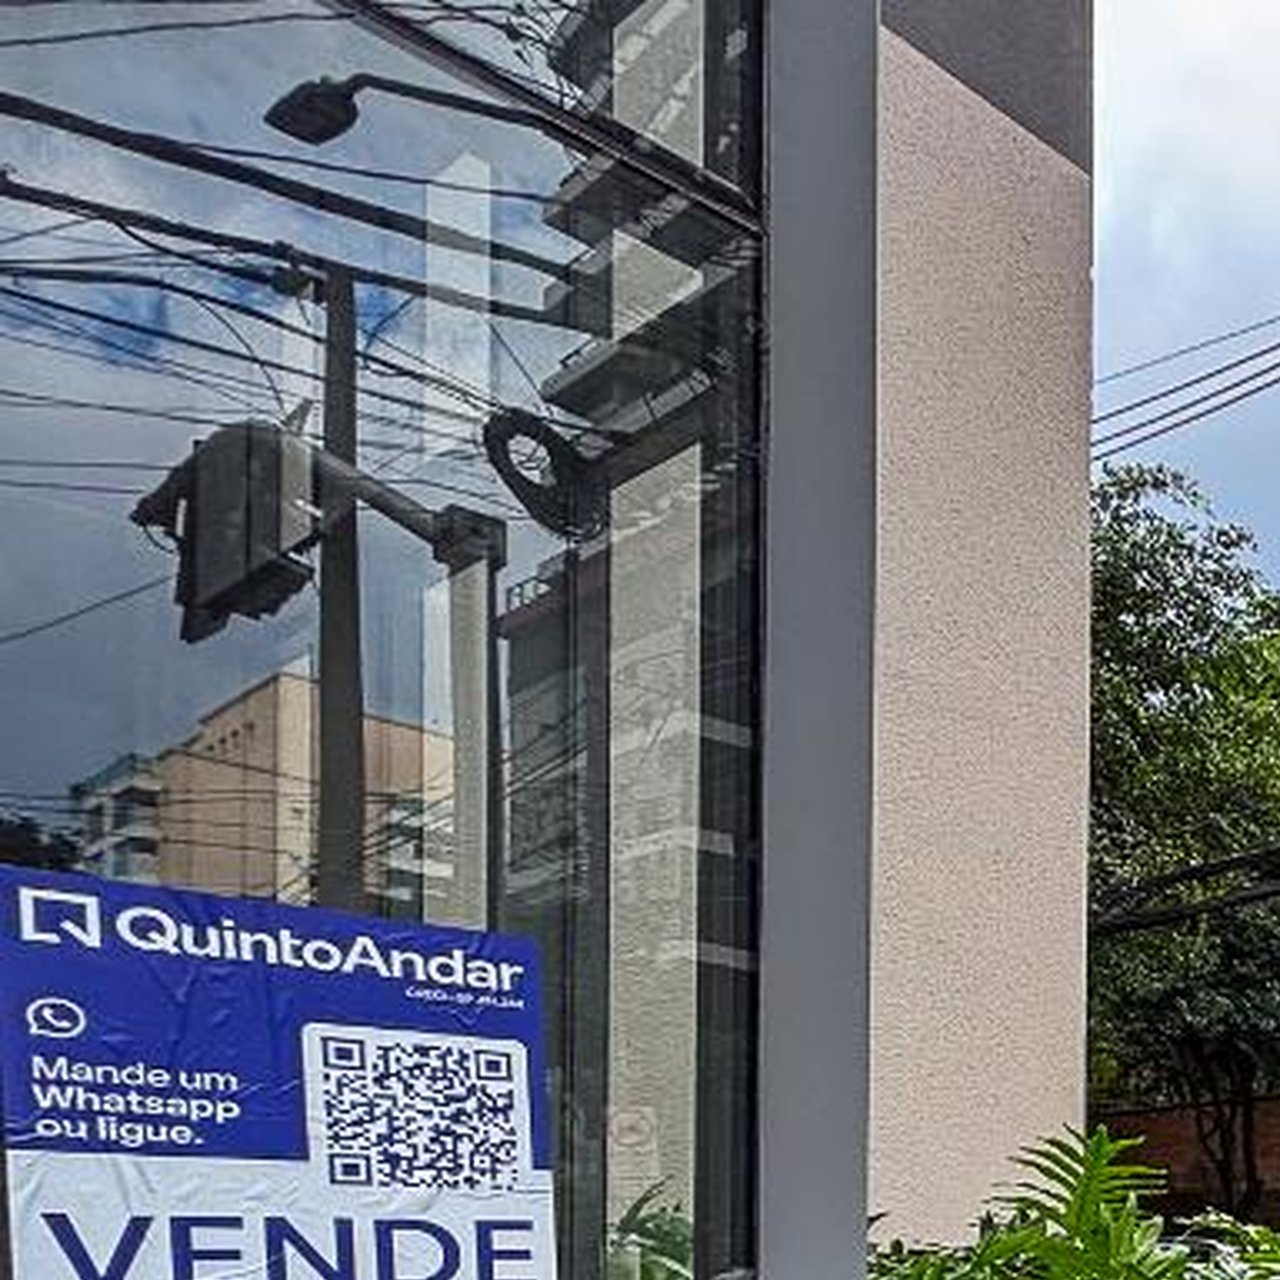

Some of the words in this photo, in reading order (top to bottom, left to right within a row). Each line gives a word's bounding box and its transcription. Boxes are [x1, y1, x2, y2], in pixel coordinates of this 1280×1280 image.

[115, 905, 525, 992] QuintoAndar
[31, 1055, 171, 1088] Mande
[179, 1071, 239, 1091] um
[31, 1083, 241, 1123] Whatsapp
[35, 1118, 88, 1140] ou
[97, 1115, 206, 1148] ligue.
